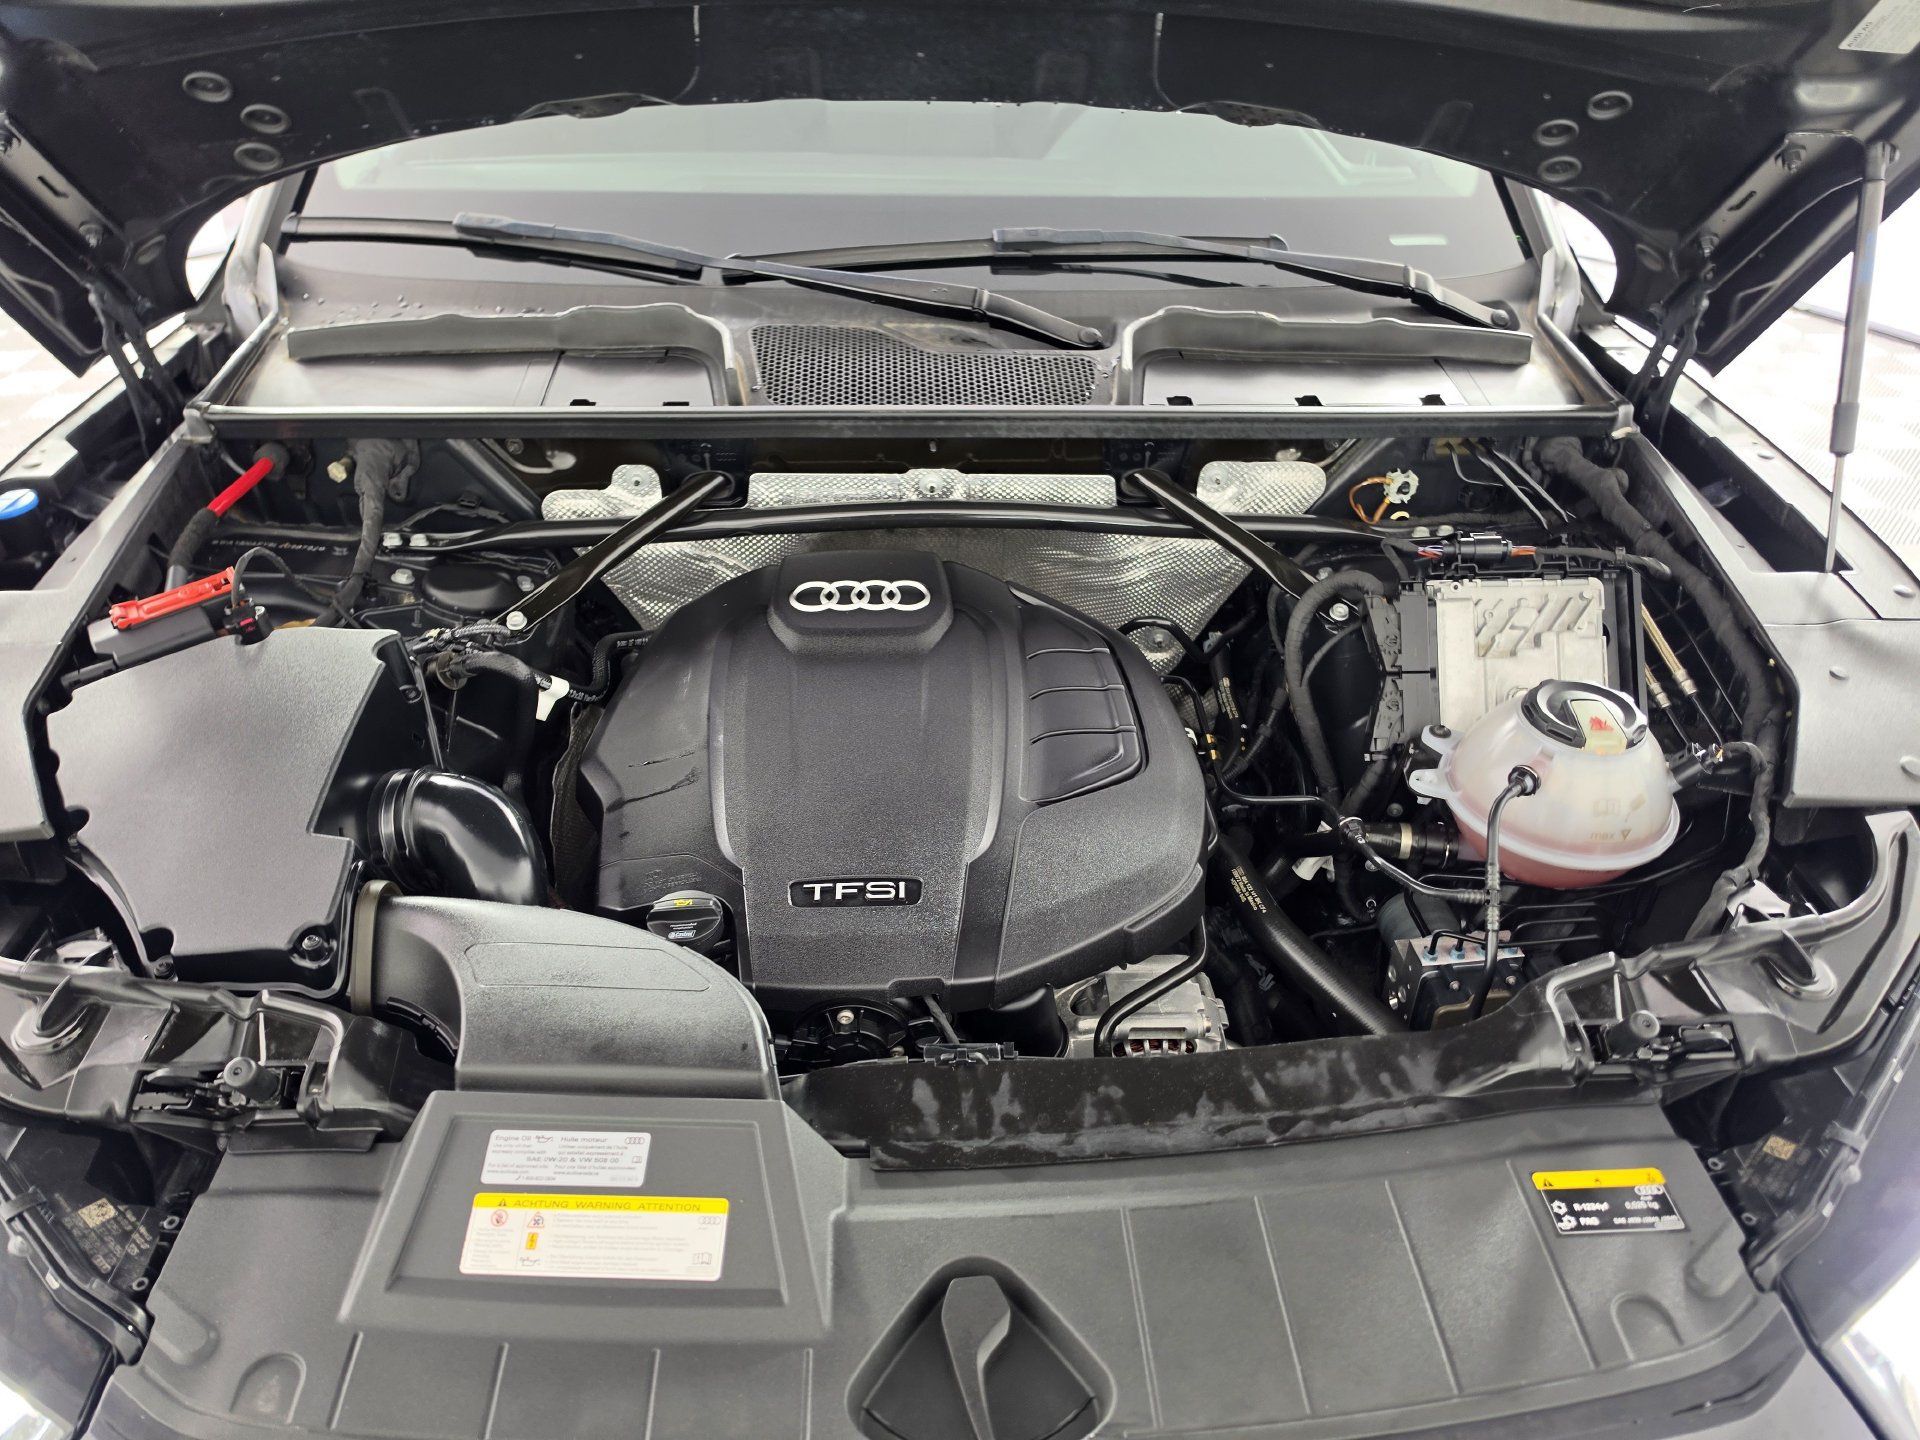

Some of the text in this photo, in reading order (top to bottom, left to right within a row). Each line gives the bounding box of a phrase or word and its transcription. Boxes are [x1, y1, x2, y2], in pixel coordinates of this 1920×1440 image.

[1589, 831, 1616, 840] max
[803, 881, 906, 901] TFSI
[513, 1200, 701, 1211] ACHTUNG WARNING ATTENTION
